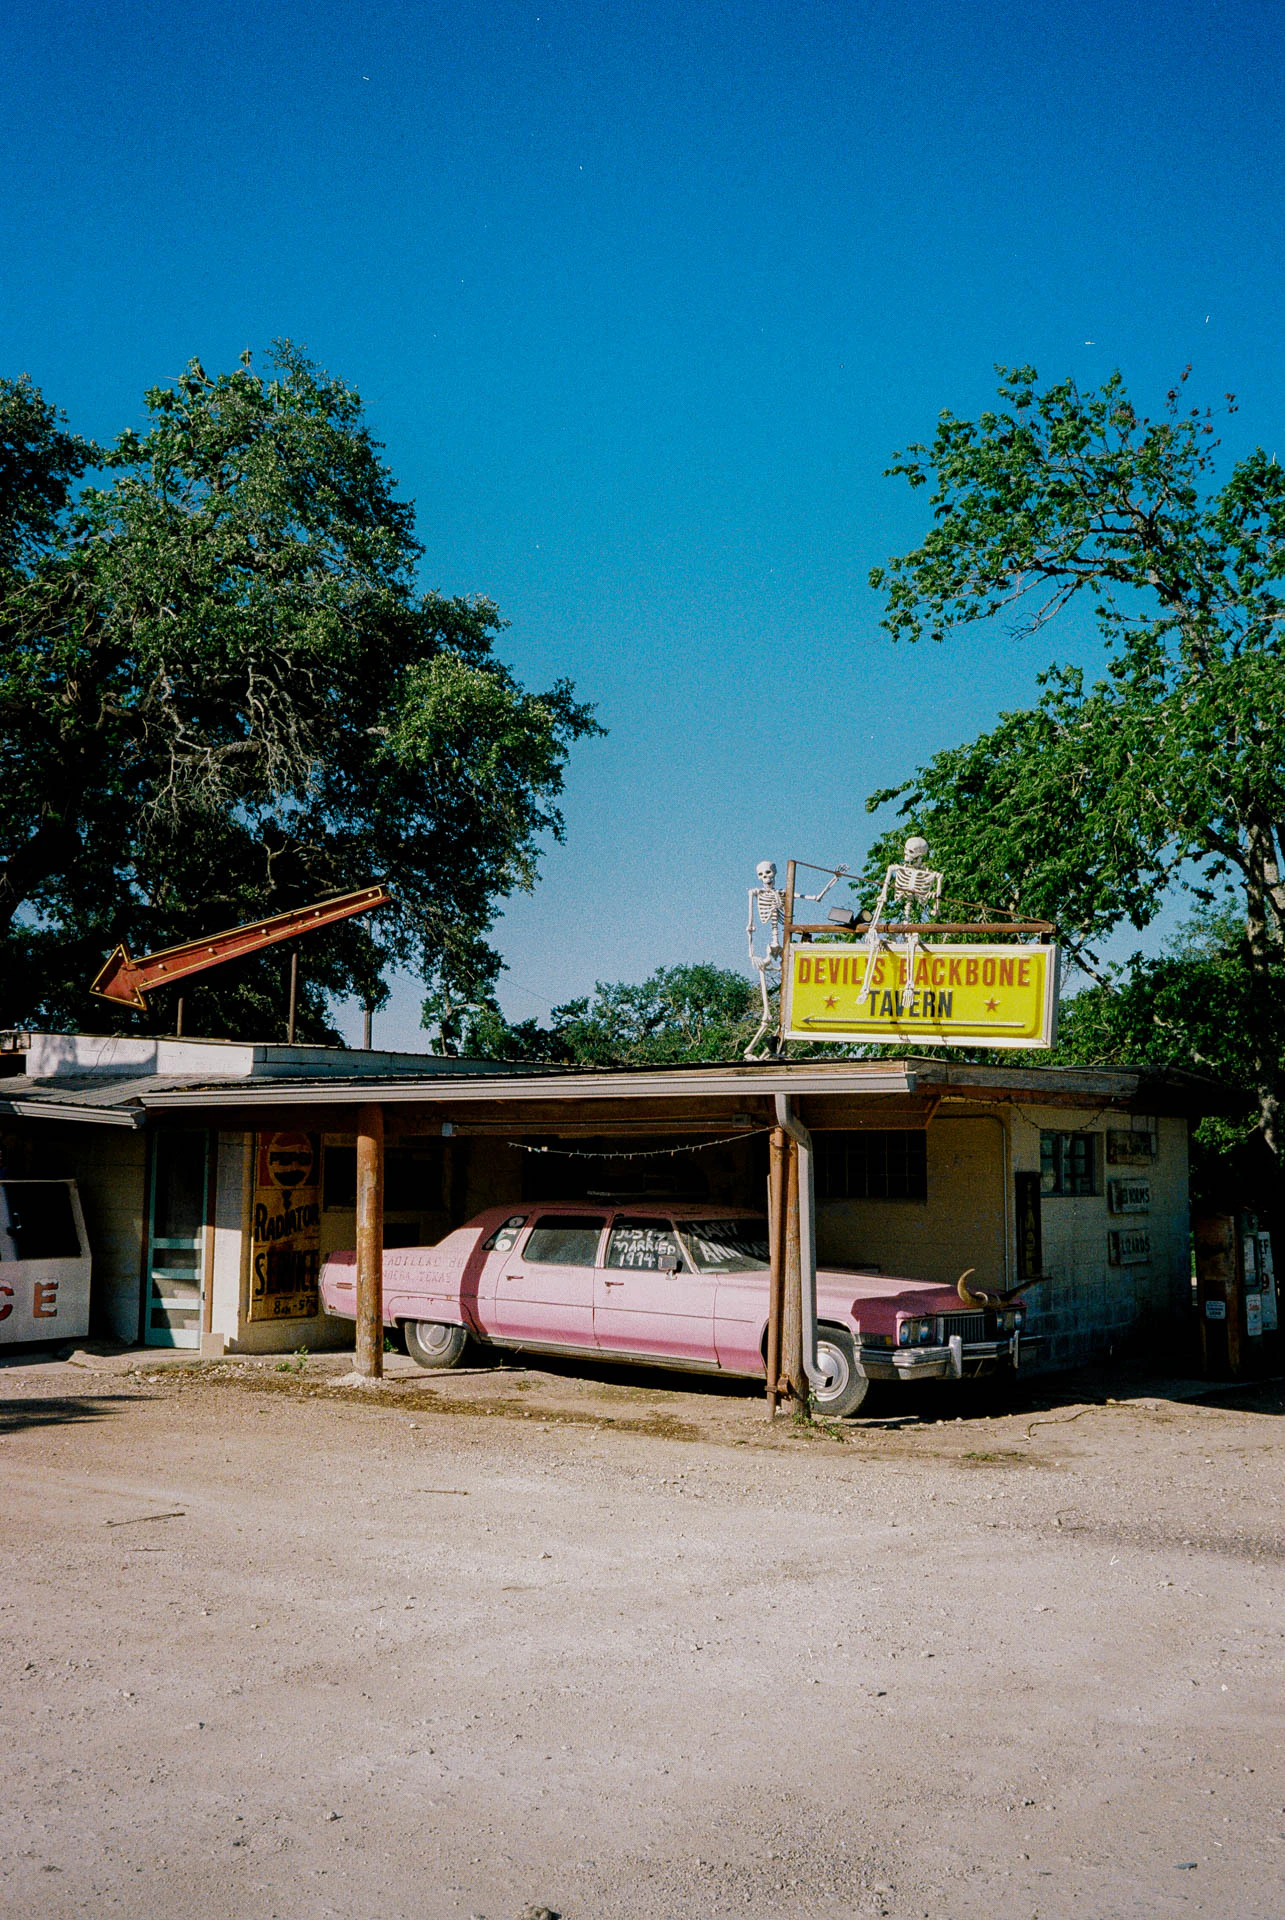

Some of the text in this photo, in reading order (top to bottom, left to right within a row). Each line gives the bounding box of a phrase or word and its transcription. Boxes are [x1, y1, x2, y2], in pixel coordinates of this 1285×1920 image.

[899, 957, 1031, 988] BACKBONE
[868, 989, 953, 1018] TAVERN
[254, 1203, 320, 1242] RADIATOR
[613, 1240, 677, 1256] MARRIED
